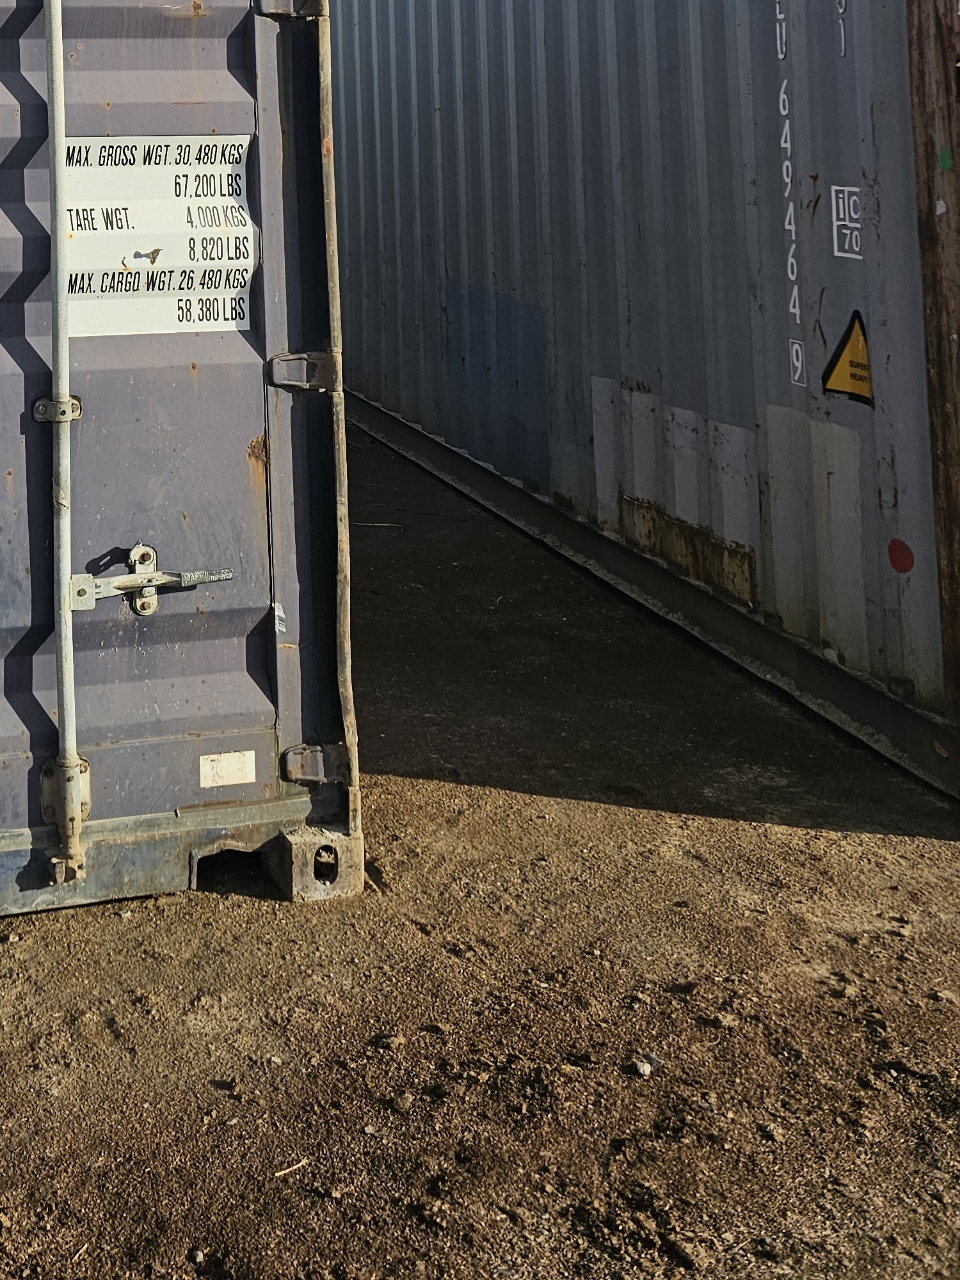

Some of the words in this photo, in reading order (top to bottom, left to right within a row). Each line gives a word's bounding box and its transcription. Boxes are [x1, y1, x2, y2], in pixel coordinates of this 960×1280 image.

[66, 146, 93, 167] MAX.
[98, 145, 137, 166] GROSS
[143, 145, 171, 165] WGT.
[220, 144, 243, 165] KGS
[174, 174, 215, 199] 67,200
[220, 174, 241, 197] LBS
[67, 208, 97, 231] TARE
[101, 207, 135, 230] WGT.
[187, 206, 221, 229] 4,000
[222, 205, 247, 227] KGS
[189, 237, 223, 262] 8,820
[227, 236, 249, 260] LBS
[841, 229, 861, 252] 70
[68, 273, 96, 294] MAX.
[101, 272, 140, 293] CARGO
[146, 270, 176, 292] WGT.
[224, 268, 248, 289] KGS
[178, 298, 219, 323] 58,380
[223, 297, 245, 321] LBS
